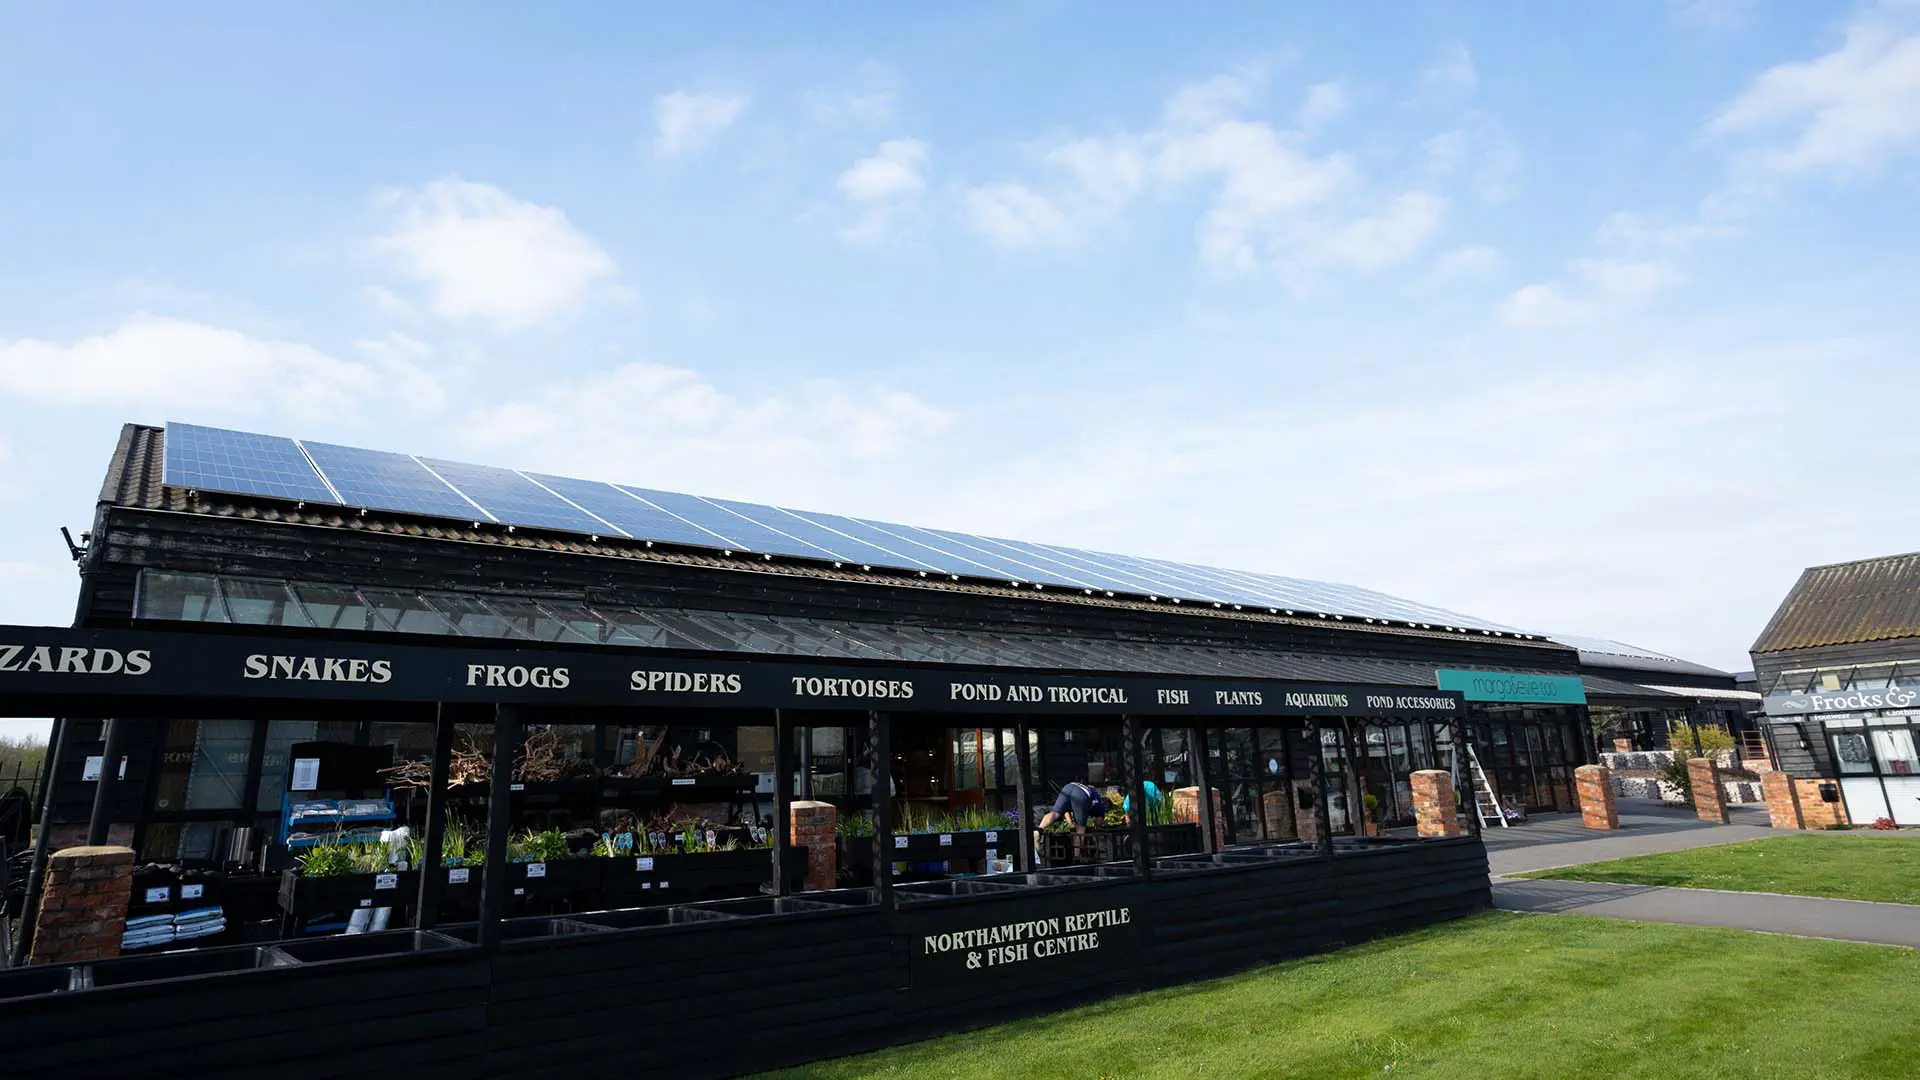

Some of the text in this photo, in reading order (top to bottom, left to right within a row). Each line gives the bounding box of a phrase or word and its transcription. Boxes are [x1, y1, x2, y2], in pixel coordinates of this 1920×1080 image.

[243, 655, 392, 683] SNAKES
[466, 664, 570, 688] FROGS
[630, 671, 742, 694] SPIDERS
[792, 677, 914, 699] TORTOISES
[950, 683, 1128, 704] POND AND TROPICAL
[1156, 689, 1190, 705] FISH
[1215, 691, 1263, 706] PLANTS
[1284, 693, 1349, 708] AQUARIUMS
[1366, 695, 1456, 710] POND ACCESSORIES
[1810, 686, 1917, 711] Frocks &
[924, 908, 1131, 955] NORTHAMPTON REPTILE
[966, 932, 1099, 970] & FISH CENTRE
